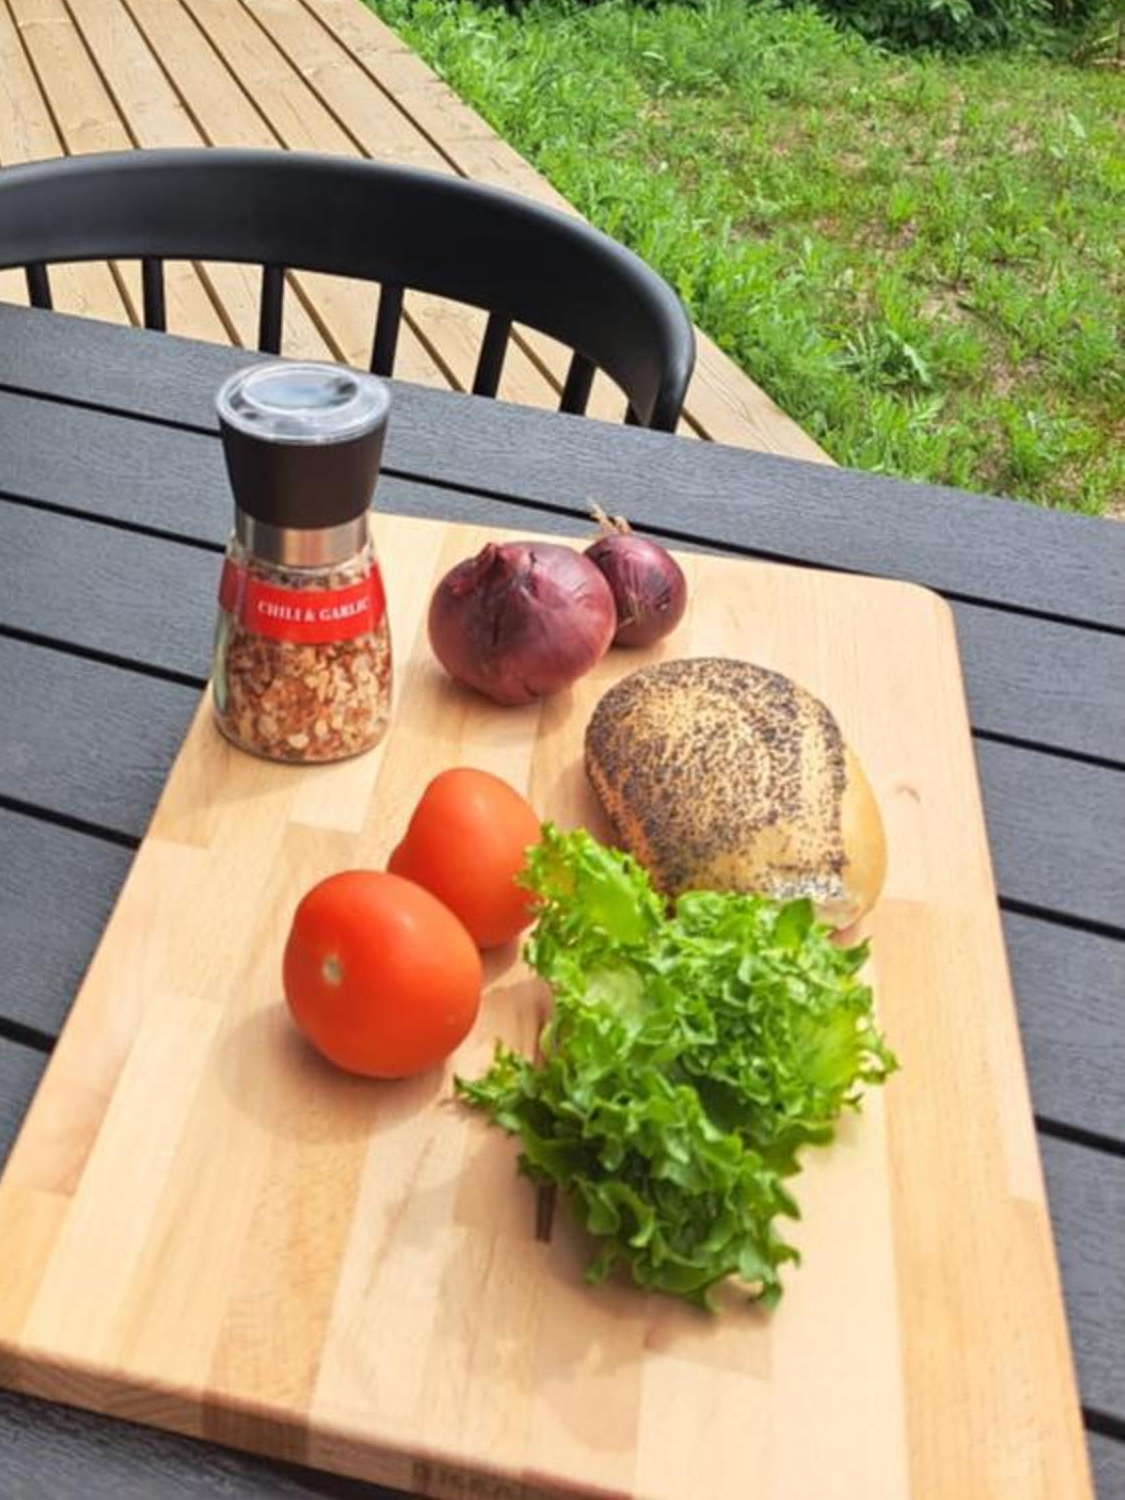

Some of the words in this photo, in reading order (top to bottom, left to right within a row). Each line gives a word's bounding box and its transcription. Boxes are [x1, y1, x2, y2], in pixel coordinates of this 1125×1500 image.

[258, 600, 301, 621] CHILI
[304, 608, 315, 621] &
[318, 596, 371, 621] GARLIC
